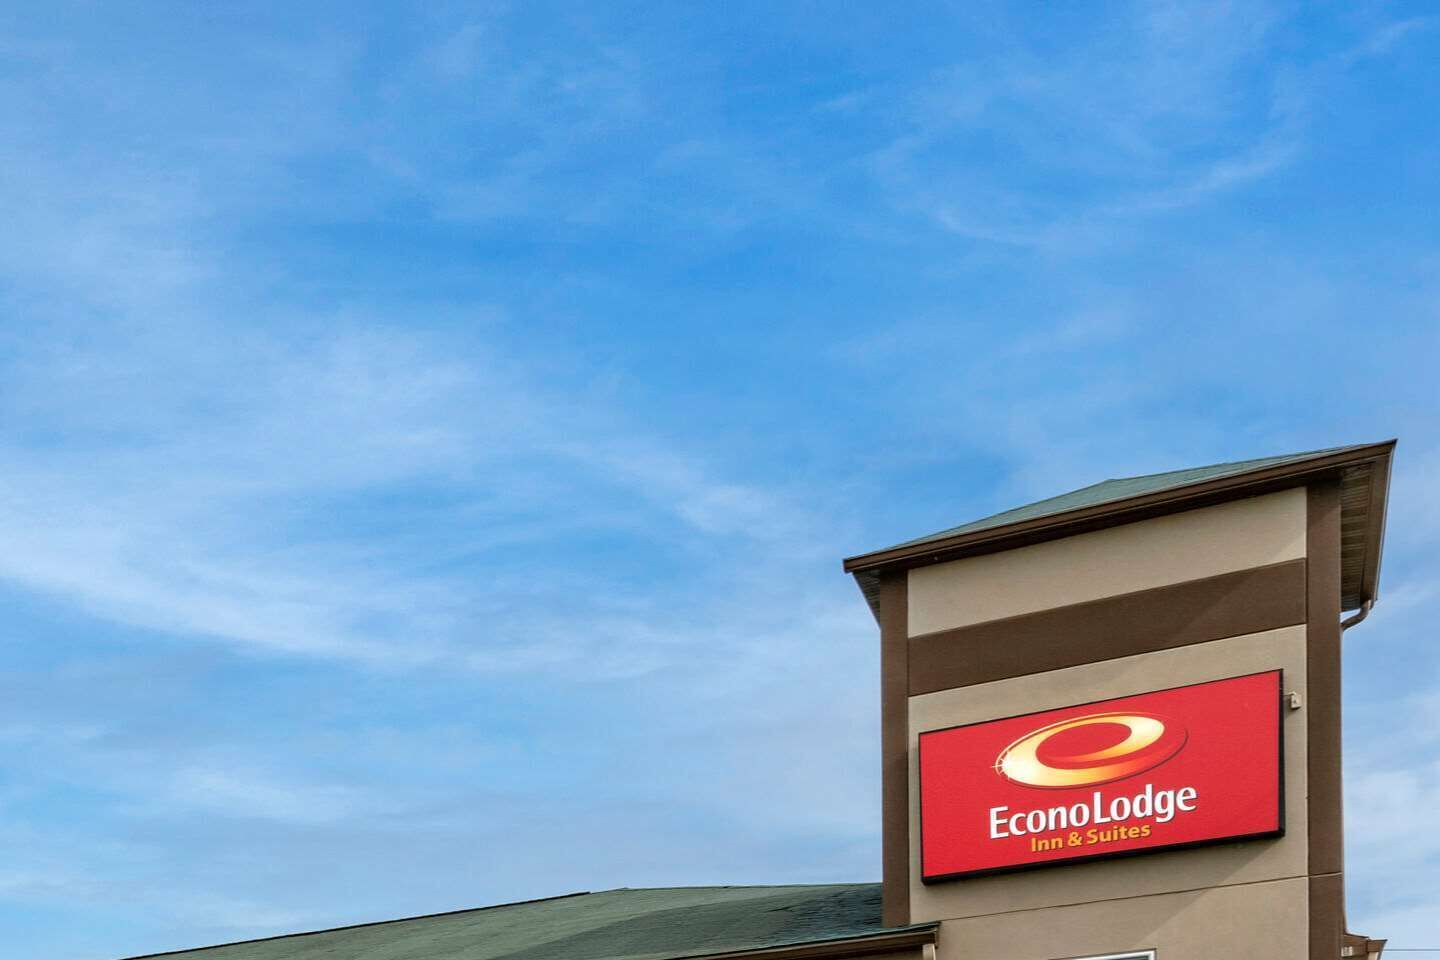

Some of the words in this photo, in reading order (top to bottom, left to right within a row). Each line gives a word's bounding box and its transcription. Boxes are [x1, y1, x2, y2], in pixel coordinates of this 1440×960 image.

[1031, 836, 1064, 852] Inn
[1067, 831, 1083, 847] &
[1086, 824, 1152, 845] Suites
